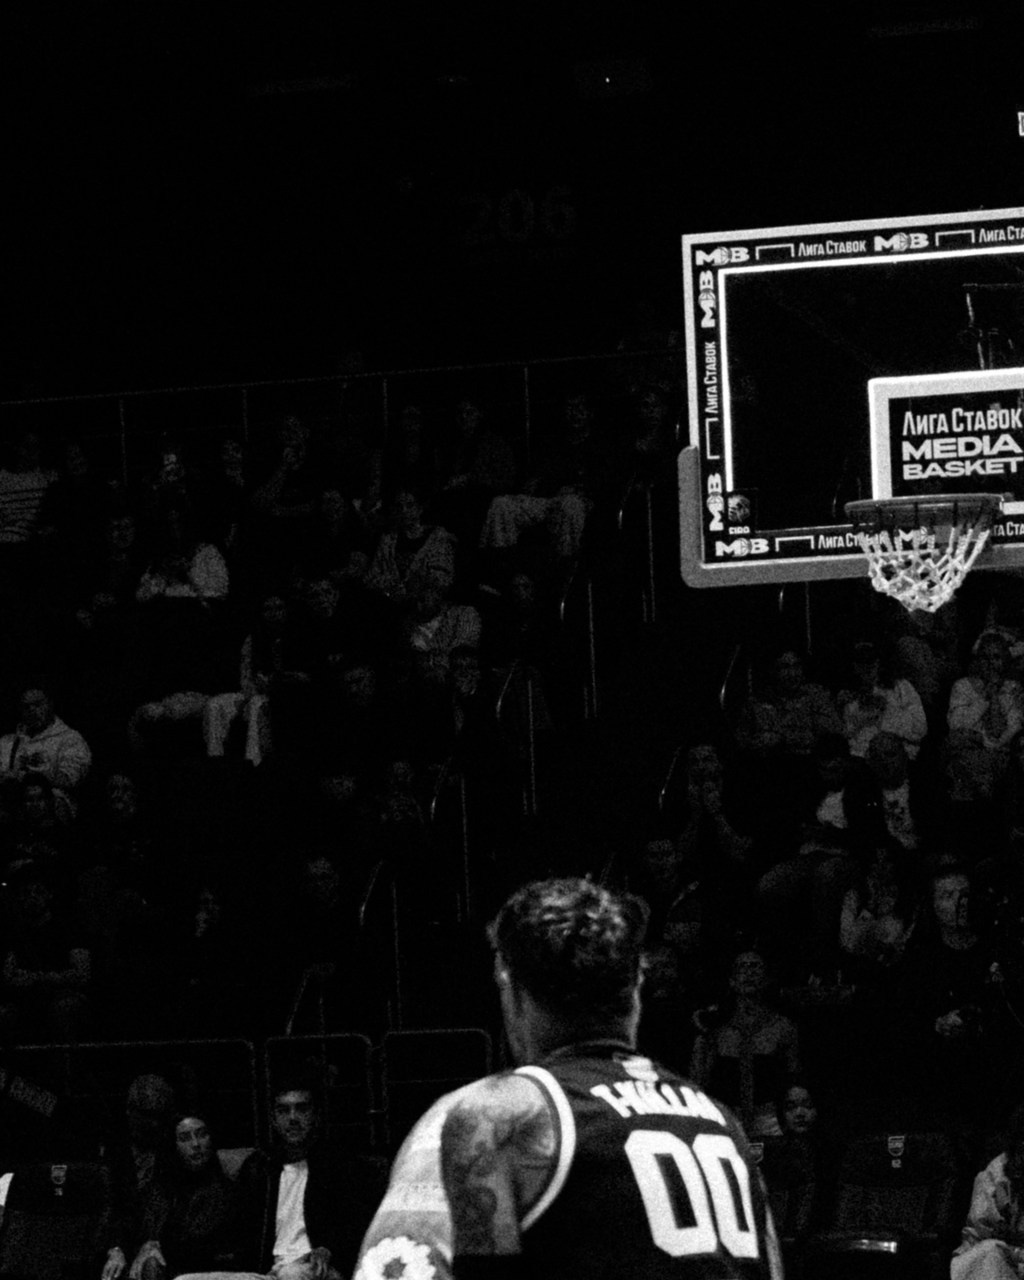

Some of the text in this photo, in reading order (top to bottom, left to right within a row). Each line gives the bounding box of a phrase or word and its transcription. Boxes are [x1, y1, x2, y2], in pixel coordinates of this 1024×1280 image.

[901, 433, 1024, 461] MEDIA
[902, 456, 1024, 480] BASKET
[624, 1129, 759, 1259] 00
